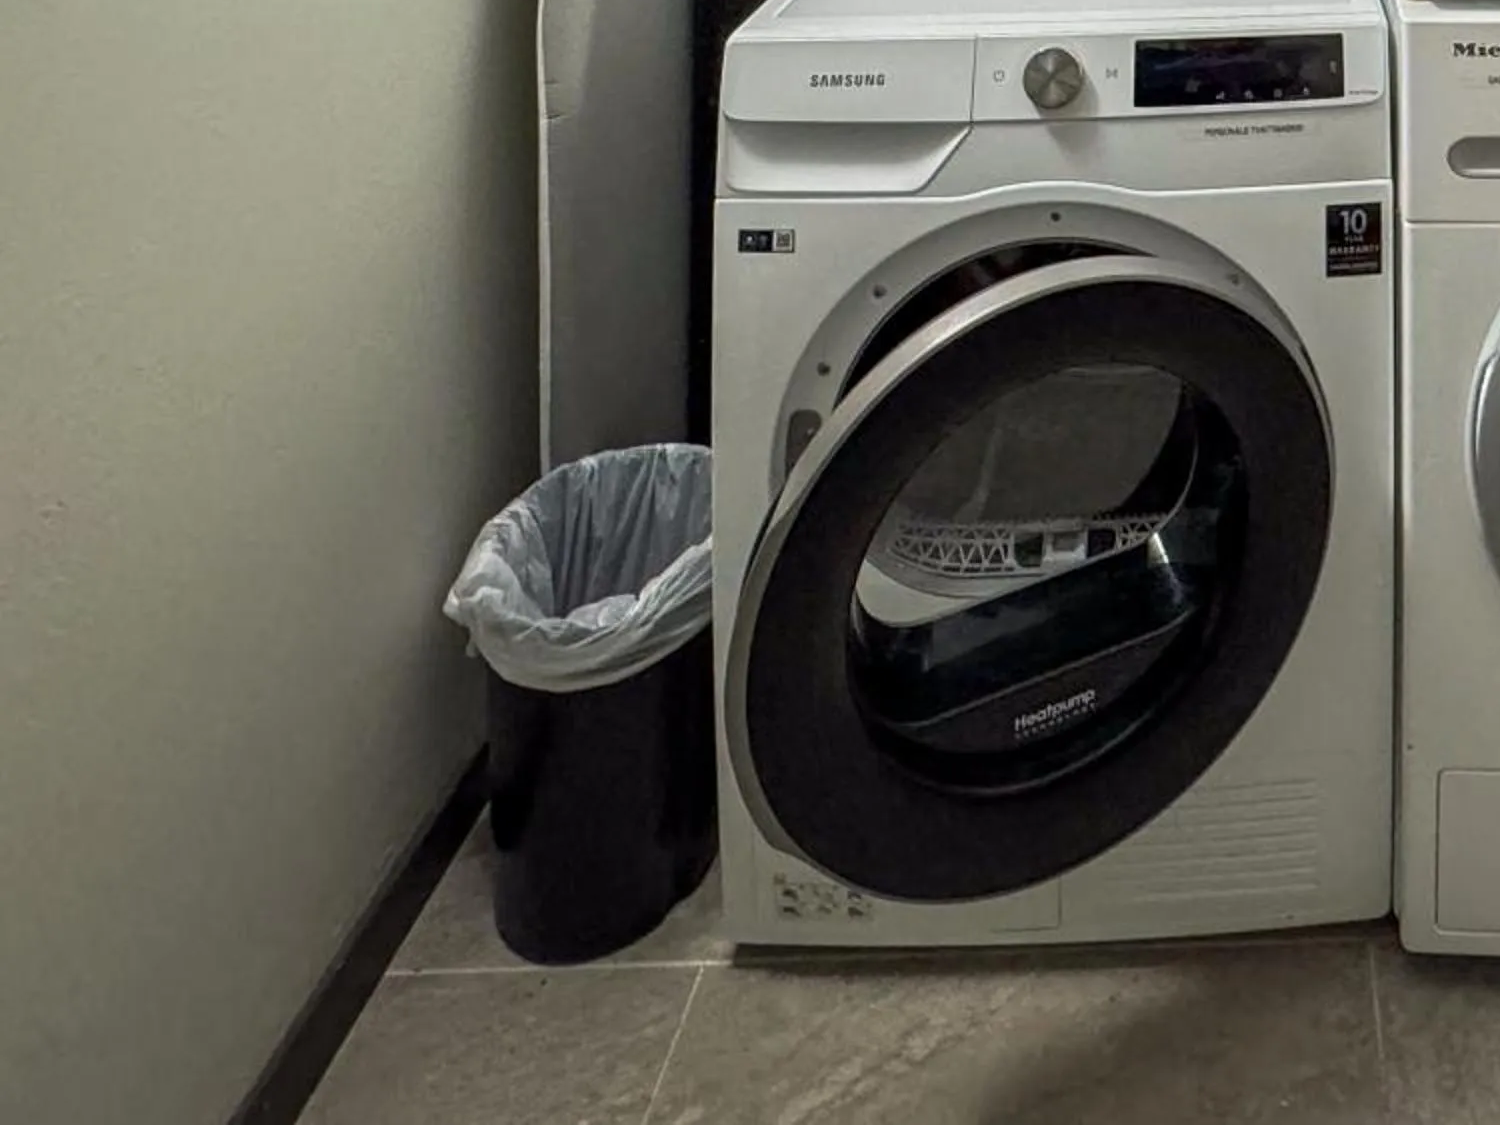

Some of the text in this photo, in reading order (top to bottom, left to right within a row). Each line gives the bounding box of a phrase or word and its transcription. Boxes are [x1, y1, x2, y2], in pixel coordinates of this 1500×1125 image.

[809, 74, 886, 88] SAMSUNG
[1339, 208, 1367, 234] 10
[1015, 689, 1096, 732] Heatpump
